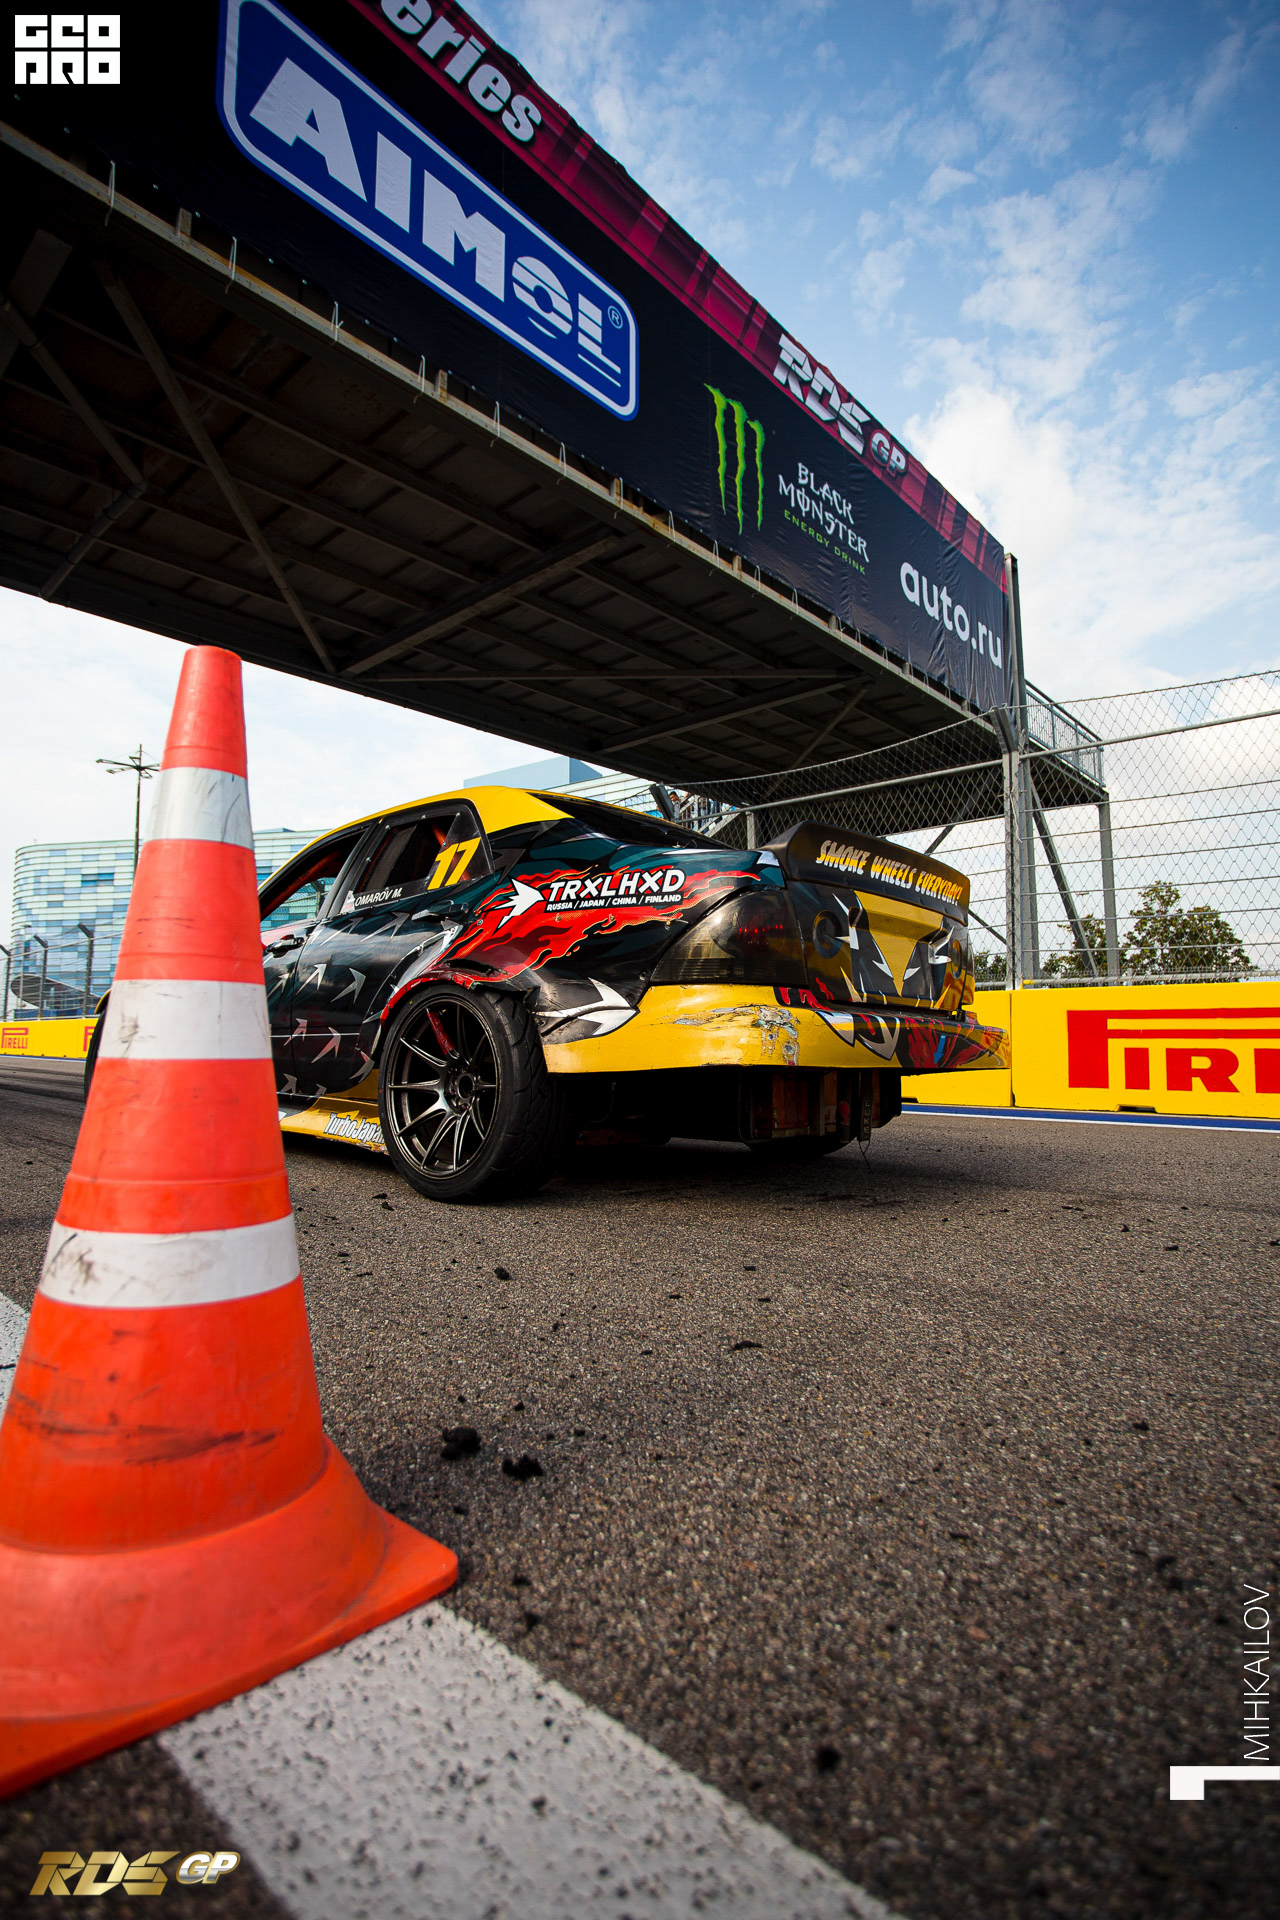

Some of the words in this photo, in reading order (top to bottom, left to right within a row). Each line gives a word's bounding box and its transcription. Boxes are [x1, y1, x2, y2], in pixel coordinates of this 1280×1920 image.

[250, 57, 622, 388] AIMOL
[773, 333, 871, 455] RDS
[869, 430, 908, 476] GP
[798, 462, 854, 525] BLACK
[784, 509, 829, 548] ENERGY
[834, 546, 865, 575] DRINK
[901, 561, 1002, 669] auto.ru
[392, 887, 403, 898] M.
[427, 836, 481, 890] 17
[549, 869, 686, 902] TRXLHXD
[815, 839, 871, 875] SMOKE
[870, 855, 918, 890] WHEELS
[915, 871, 964, 906] EVERYDAY!
[546, 902, 573, 911] RUSSIA
[579, 899, 605, 909] JAPAN
[612, 896, 637, 906] CHINA
[645, 894, 682, 904] FINLAND
[1, 1027, 29, 1049] PIRELLI
